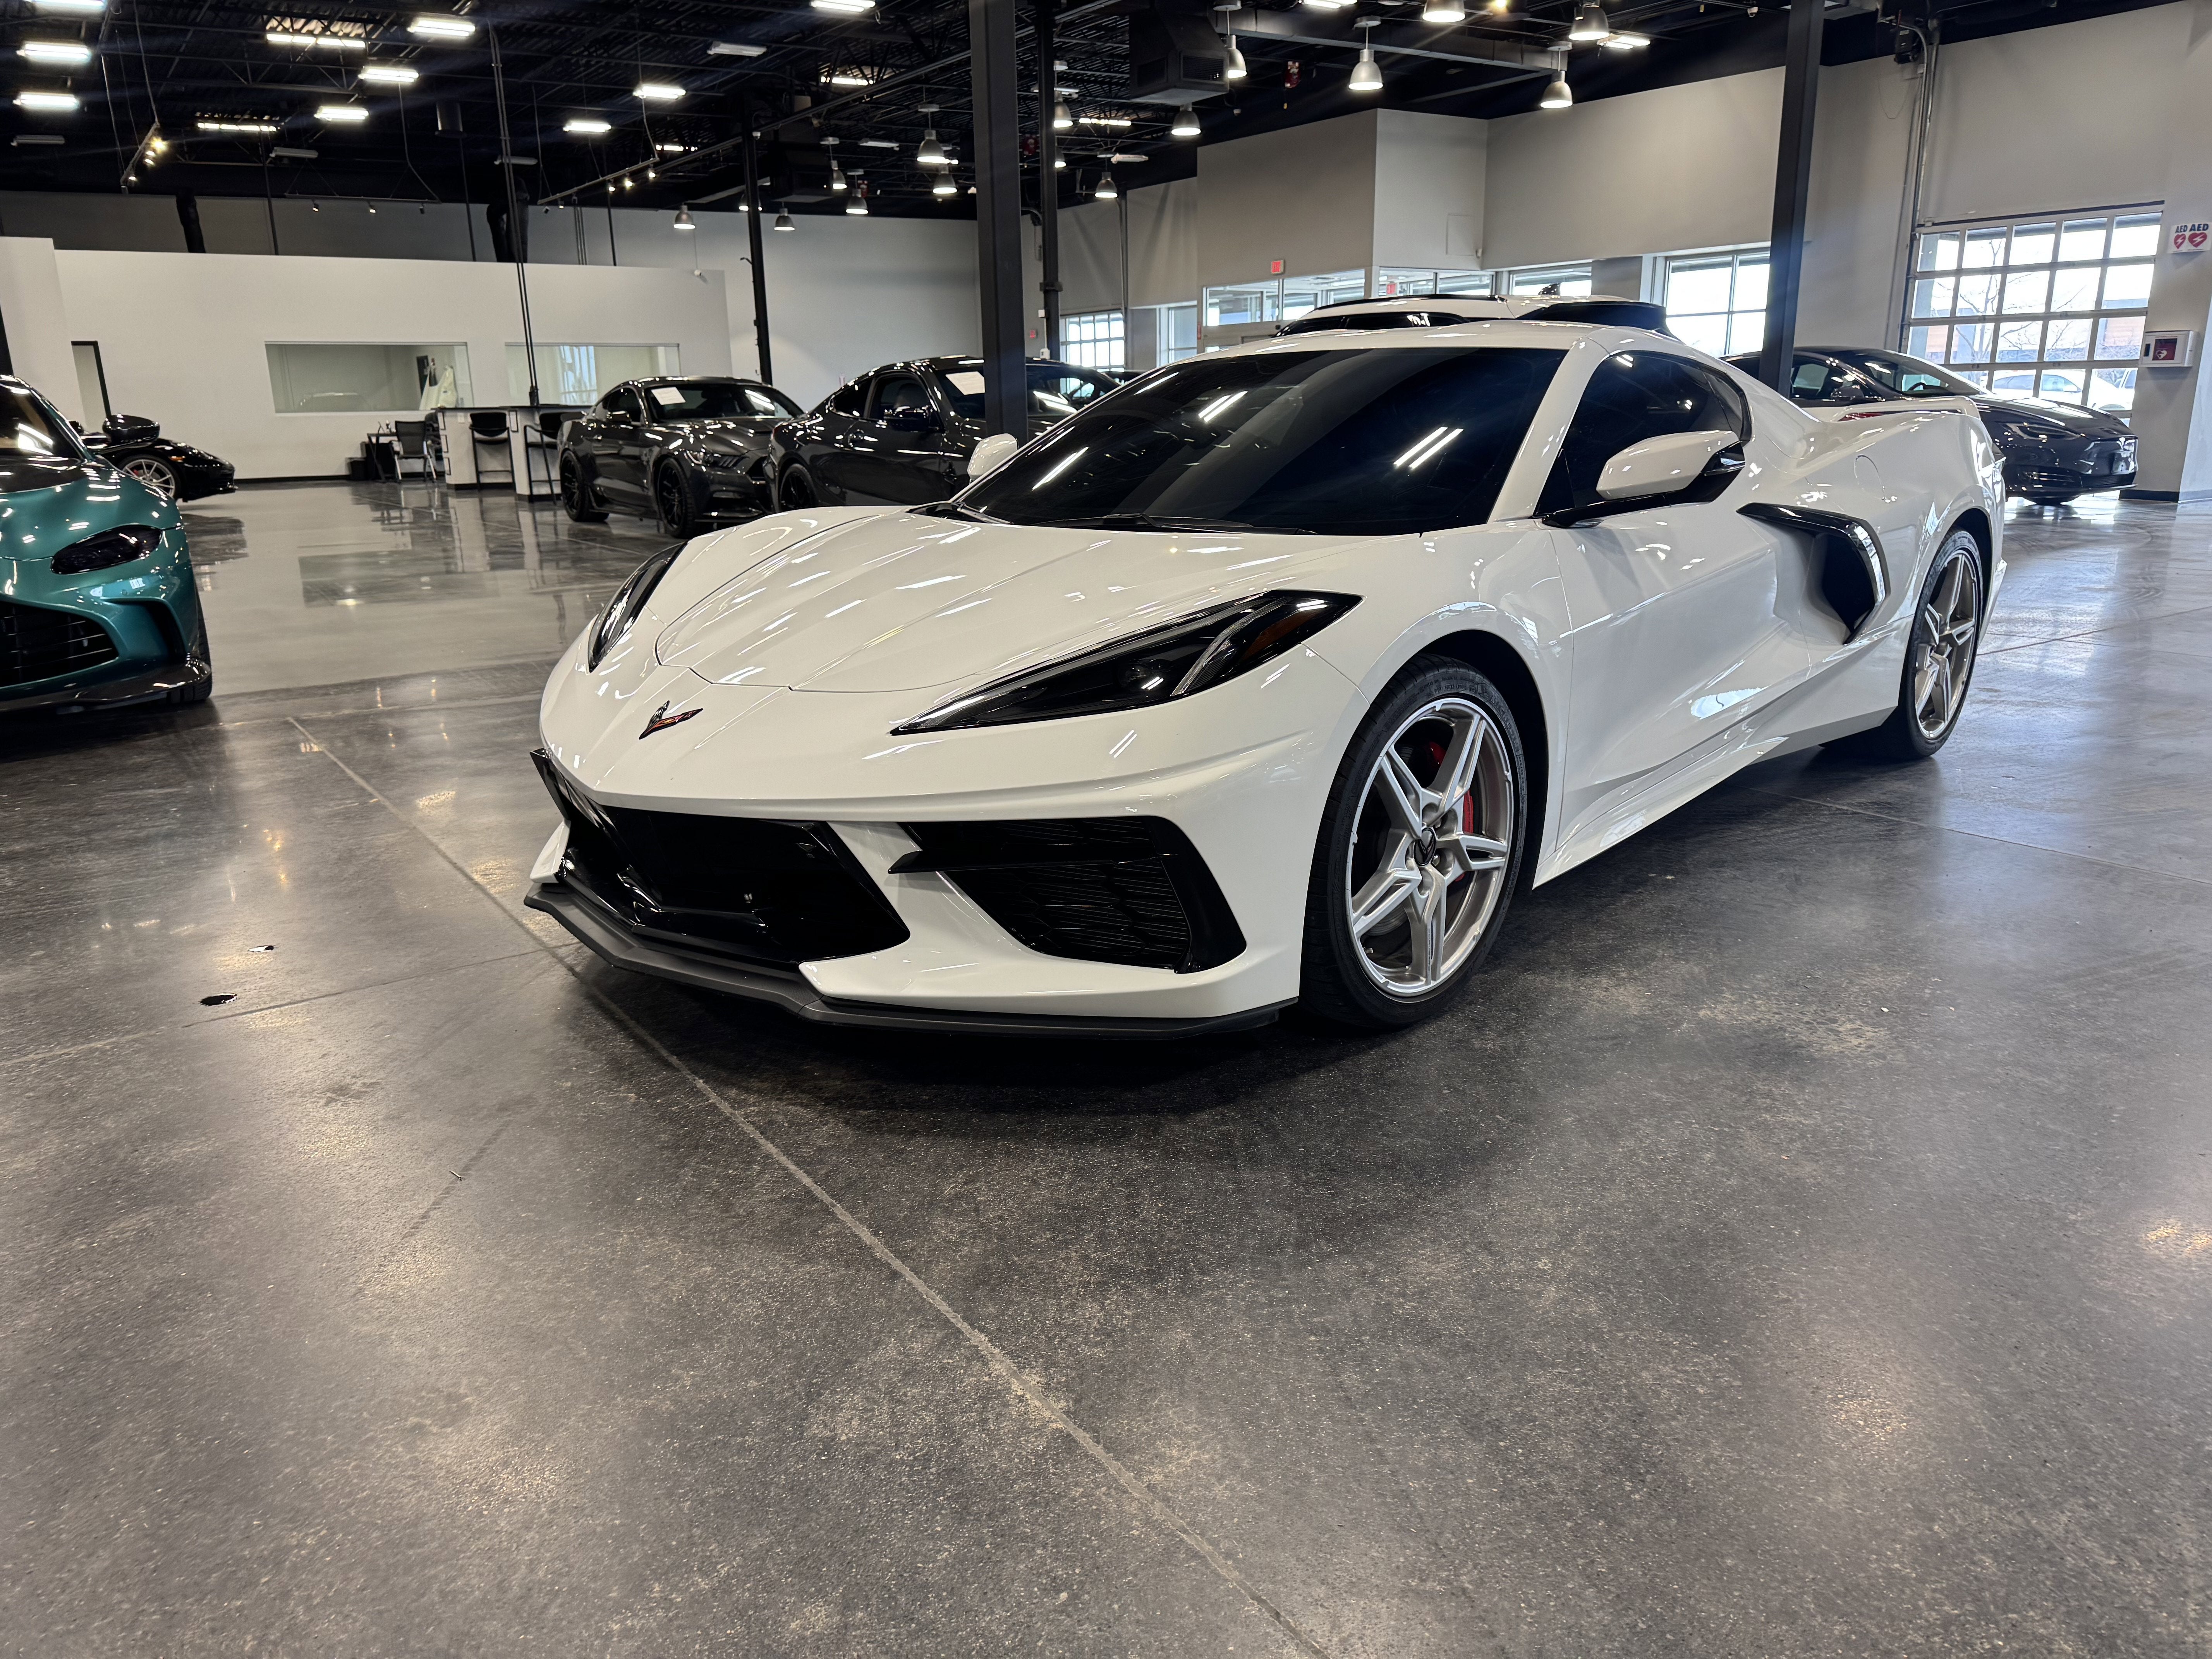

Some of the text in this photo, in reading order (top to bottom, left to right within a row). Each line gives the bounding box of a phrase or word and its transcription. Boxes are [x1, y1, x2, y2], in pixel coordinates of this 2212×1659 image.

[2175, 225, 2188, 233] AED
[2189, 223, 2209, 232] AED
[1490, 694, 1519, 749] MICHELIN
